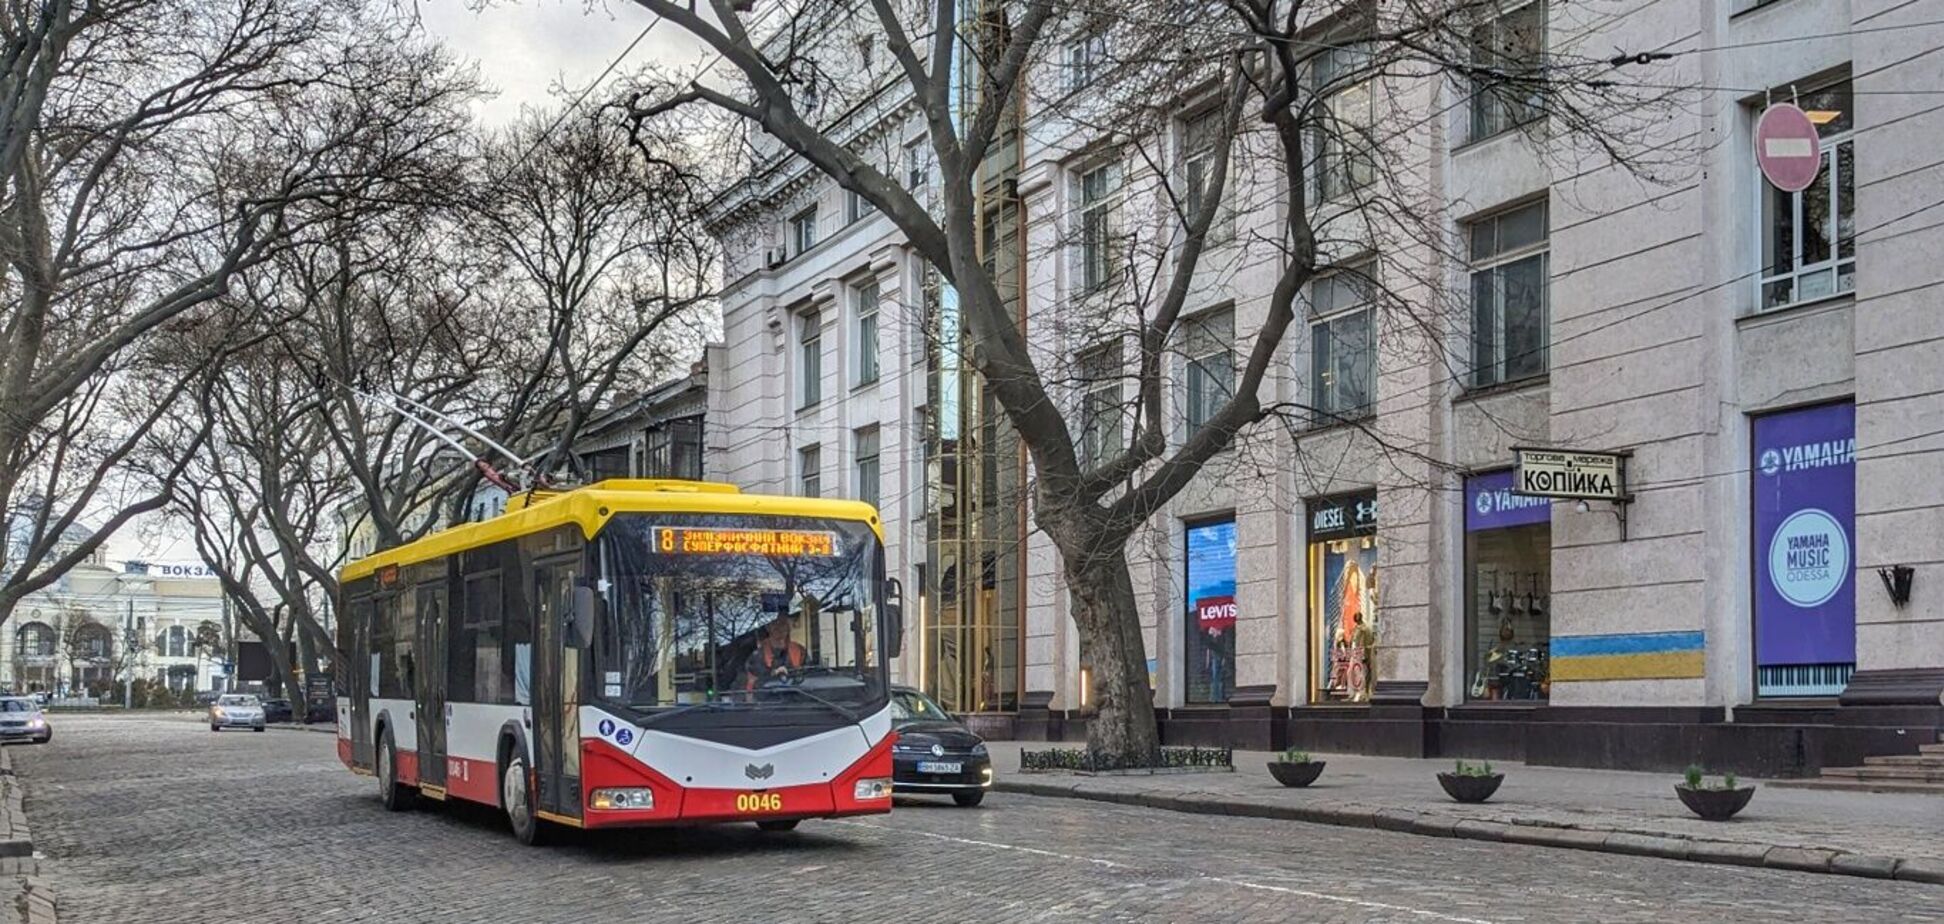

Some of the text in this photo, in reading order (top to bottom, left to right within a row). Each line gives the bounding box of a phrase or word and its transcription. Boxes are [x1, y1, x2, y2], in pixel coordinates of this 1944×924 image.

[1782, 438, 1856, 471] YAMAHA
[1524, 468, 1614, 495] КОПІЙКА
[1314, 507, 1345, 530] DIESEL
[661, 529, 675, 551] 8
[1787, 533, 1829, 550] YAMAHA
[1787, 548, 1830, 568] MUSIC
[162, 565, 214, 576] ВОКЗА
[1786, 569, 1830, 582] ODESSA
[737, 793, 781, 811] 0046
